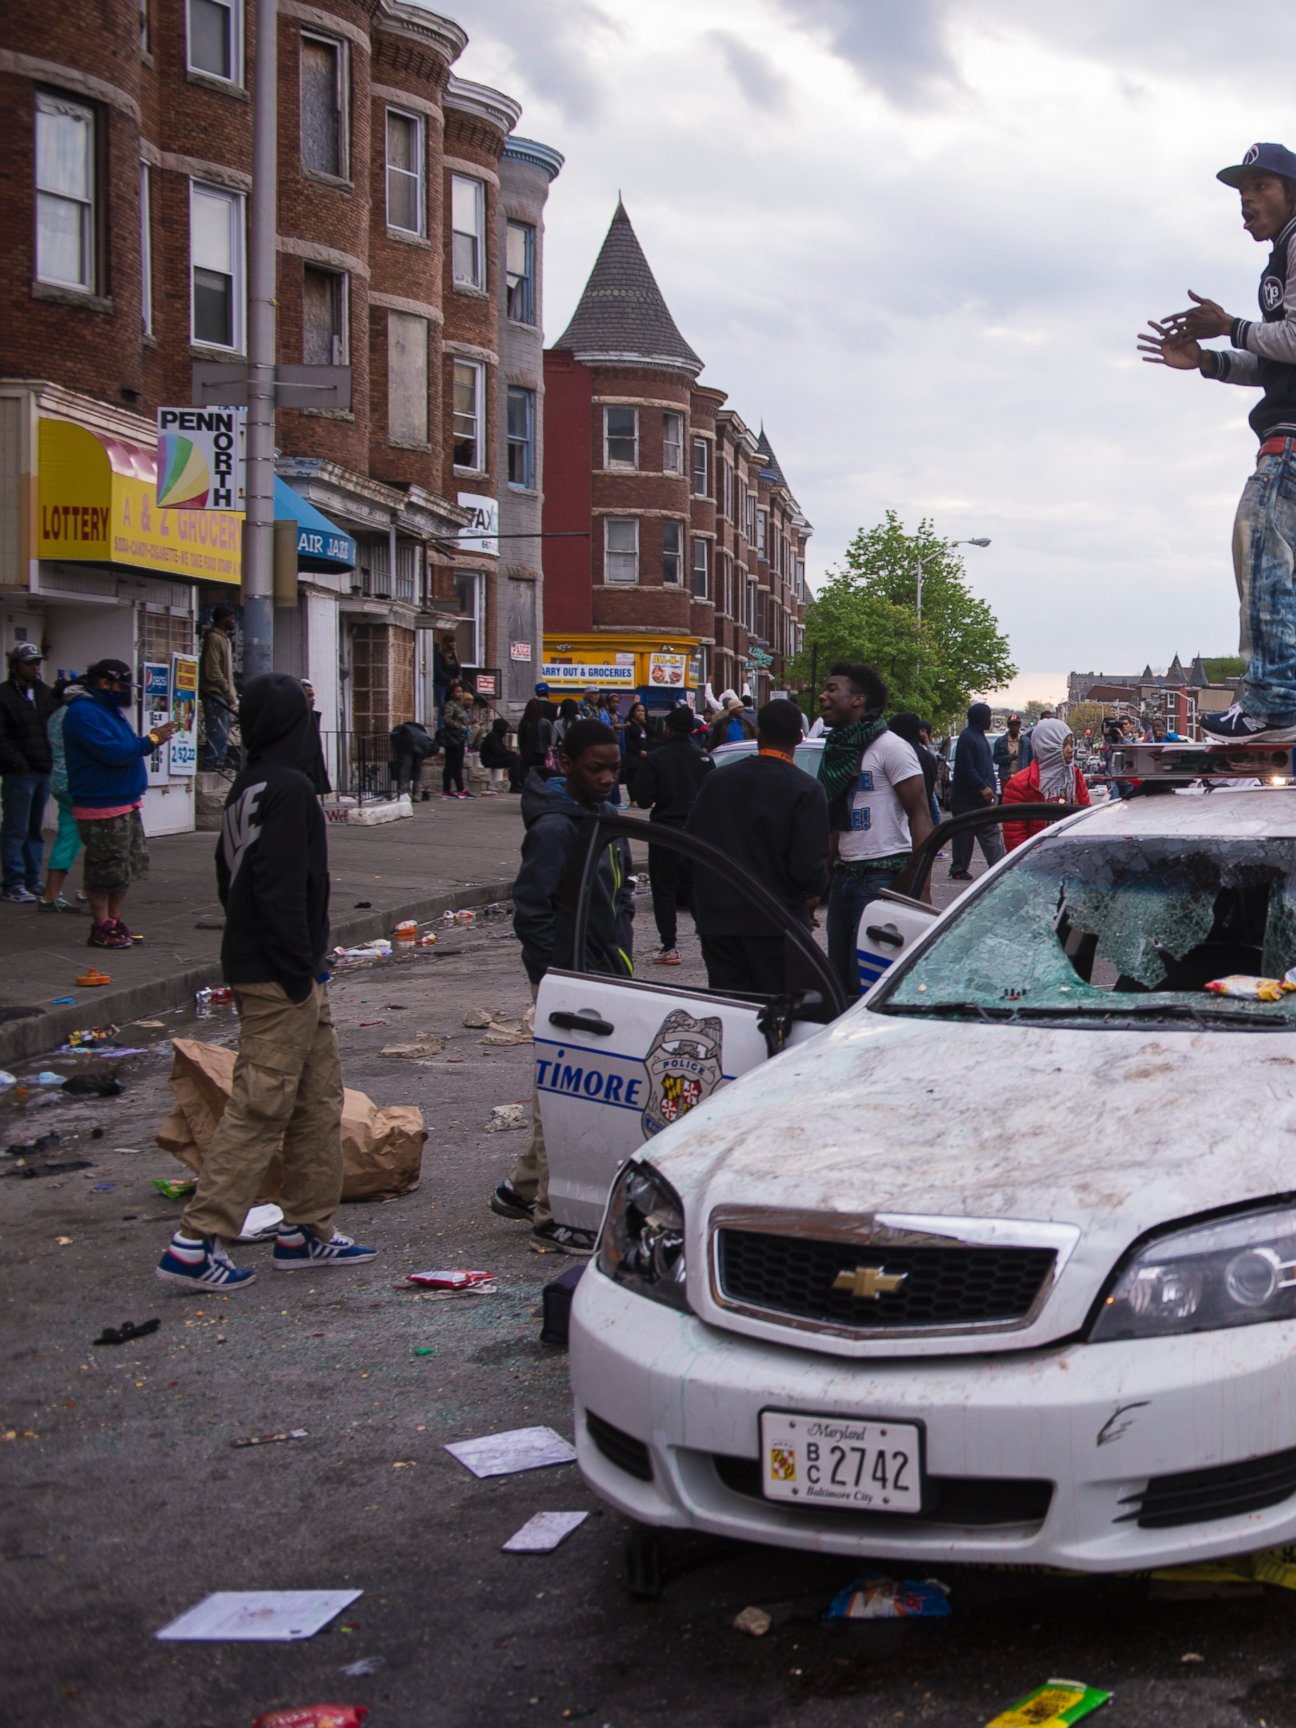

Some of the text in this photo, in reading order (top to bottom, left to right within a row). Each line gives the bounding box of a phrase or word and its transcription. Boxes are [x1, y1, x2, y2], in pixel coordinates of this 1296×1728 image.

[160, 411, 233, 432] PENN
[43, 505, 110, 541] LOTTERY
[122, 497, 131, 527] A
[141, 493, 152, 533] &
[563, 667, 578, 677] OUT
[580, 667, 586, 677] &
[588, 667, 632, 678] GROCERIES
[662, 1059, 706, 1076] POLICE
[807, 1422, 866, 1443] Maryland
[830, 1446, 909, 1491] 2742
[806, 1486, 873, 1504] Baltimore City
